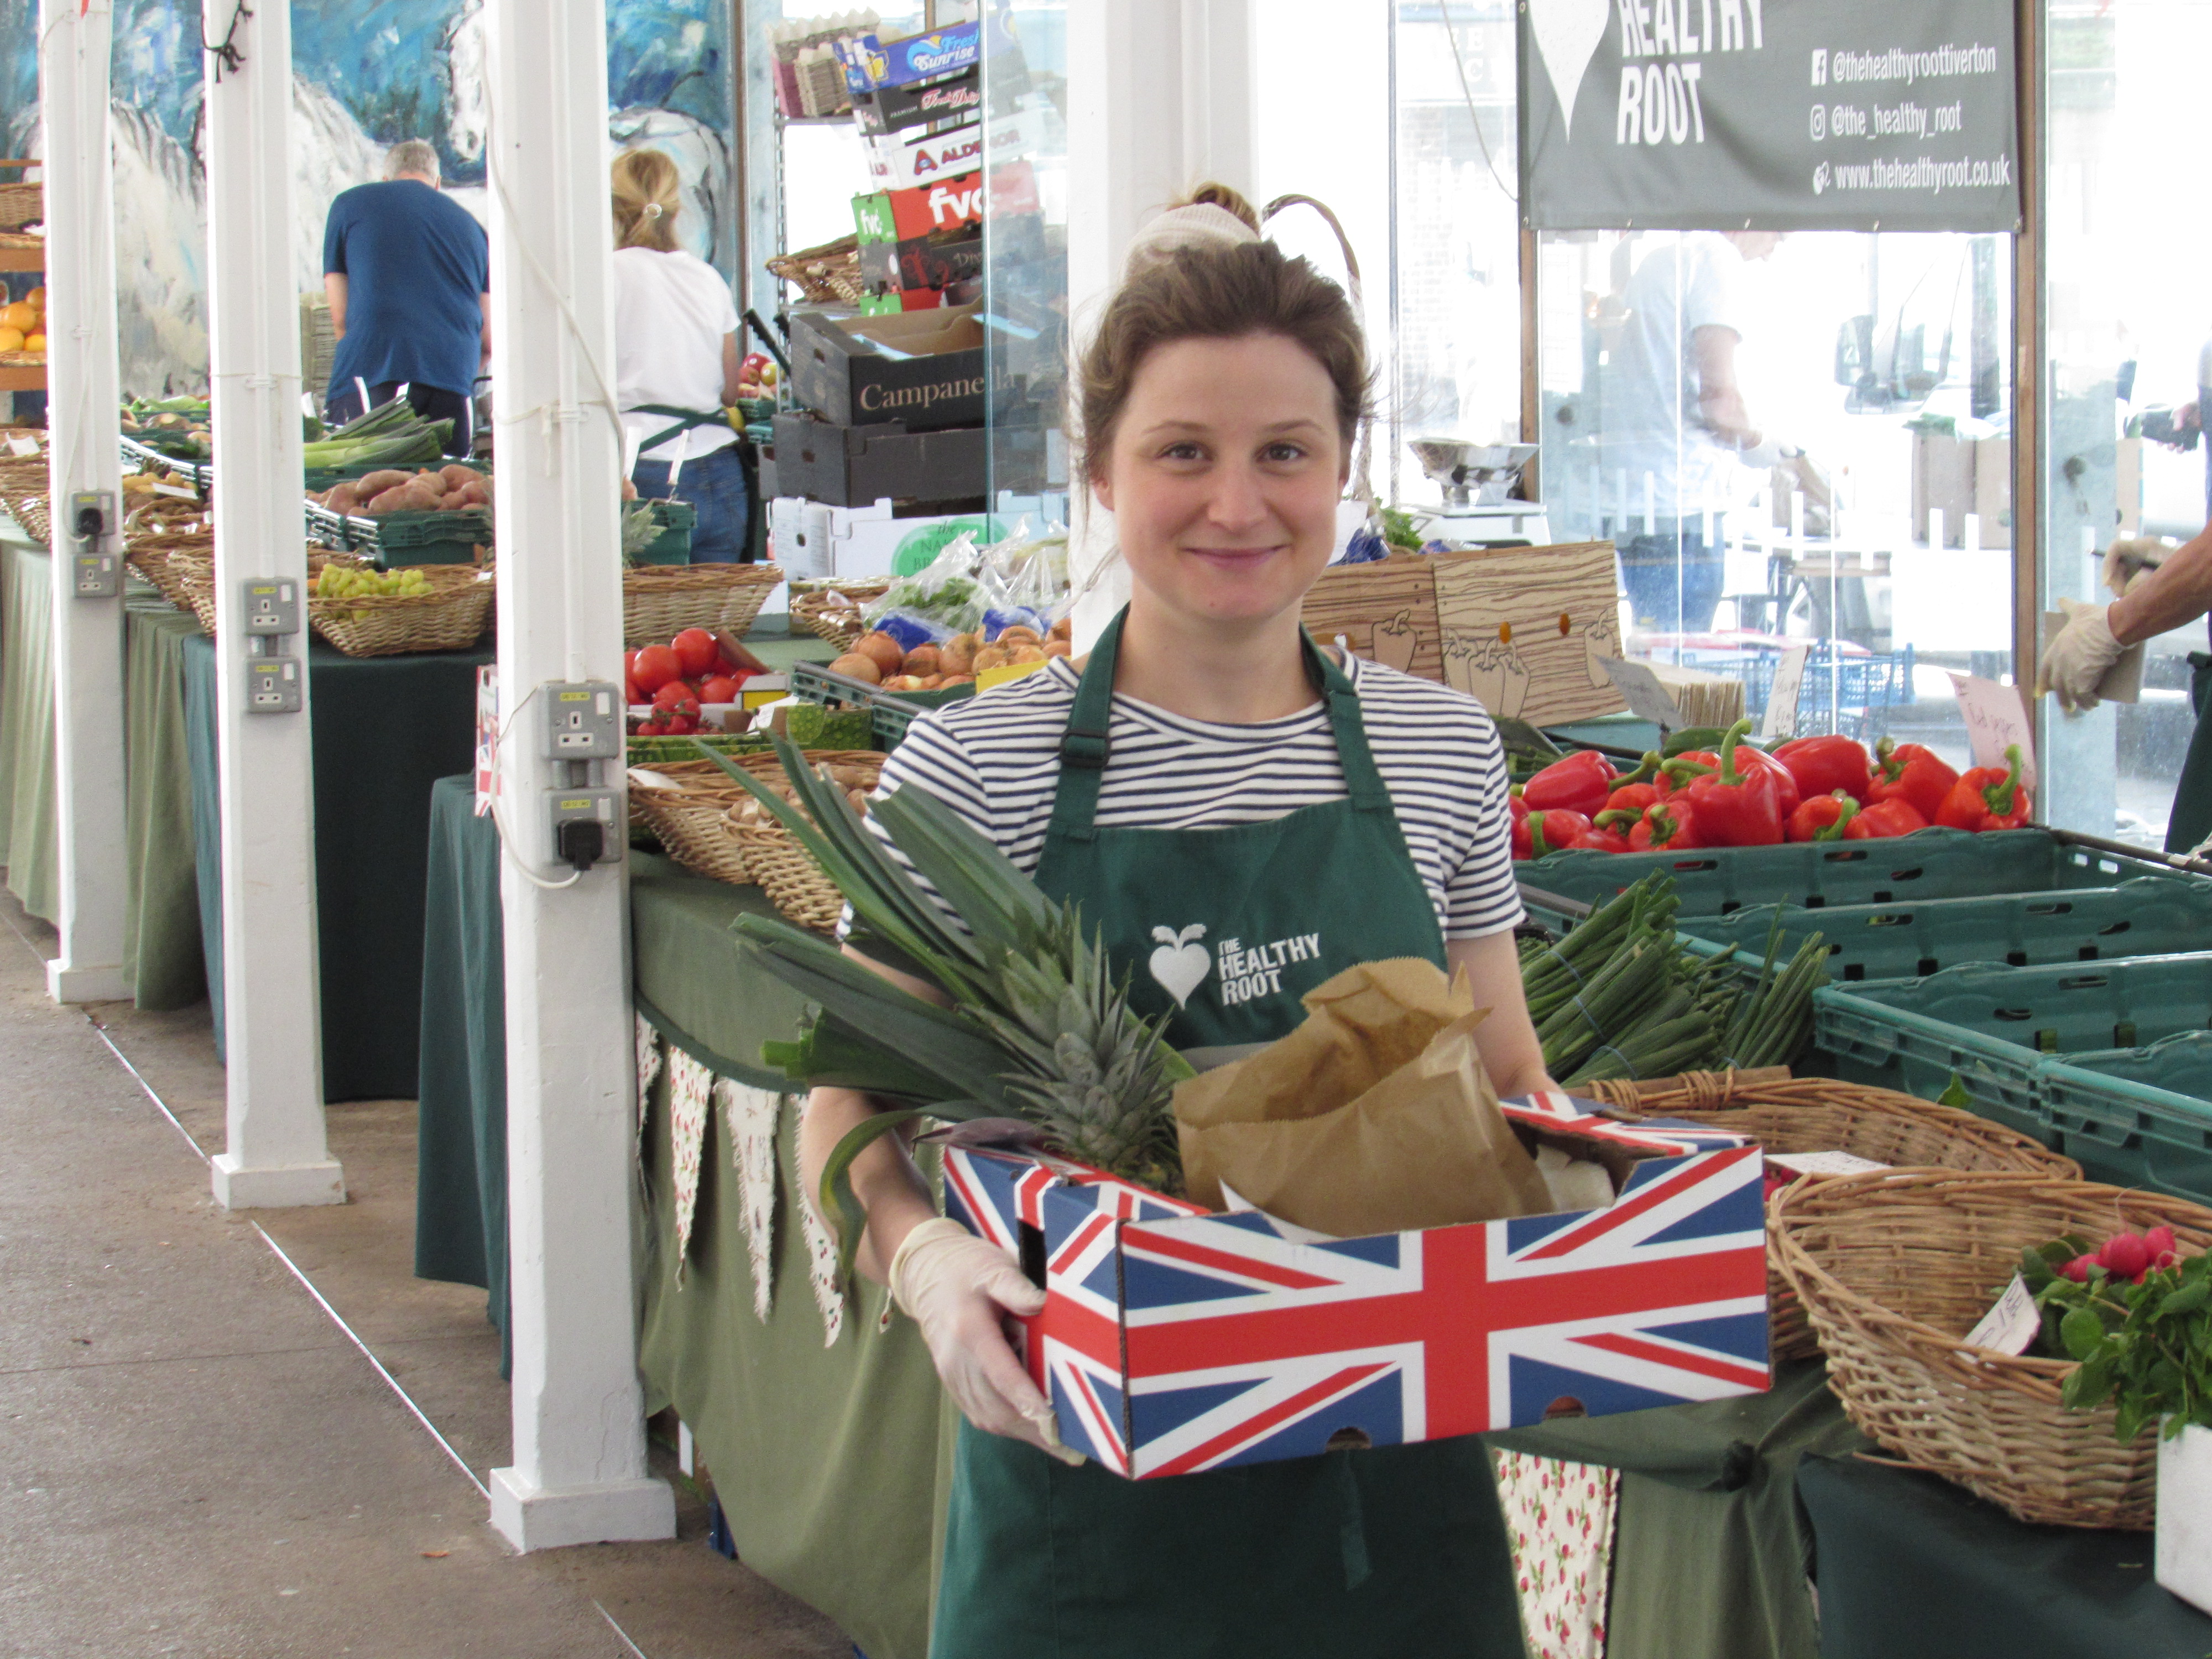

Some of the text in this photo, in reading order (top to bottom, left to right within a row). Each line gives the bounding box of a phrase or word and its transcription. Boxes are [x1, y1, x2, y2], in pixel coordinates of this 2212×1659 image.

[913, 45, 975, 71] Sunrise
[1832, 42, 1997, 85] @thehealthyroottiverton
[1616, 62, 1704, 145] ROOT
[1832, 100, 1962, 140] @the_healthy_root
[1834, 153, 2011, 195] www.thehealthyroot.co.uk
[859, 365, 1015, 411] Campanela
[938, 521, 956, 534] the
[1218, 937, 1242, 957] THE
[1218, 932, 1321, 982] HEALTHY
[1222, 968, 1282, 1006] ROOT
